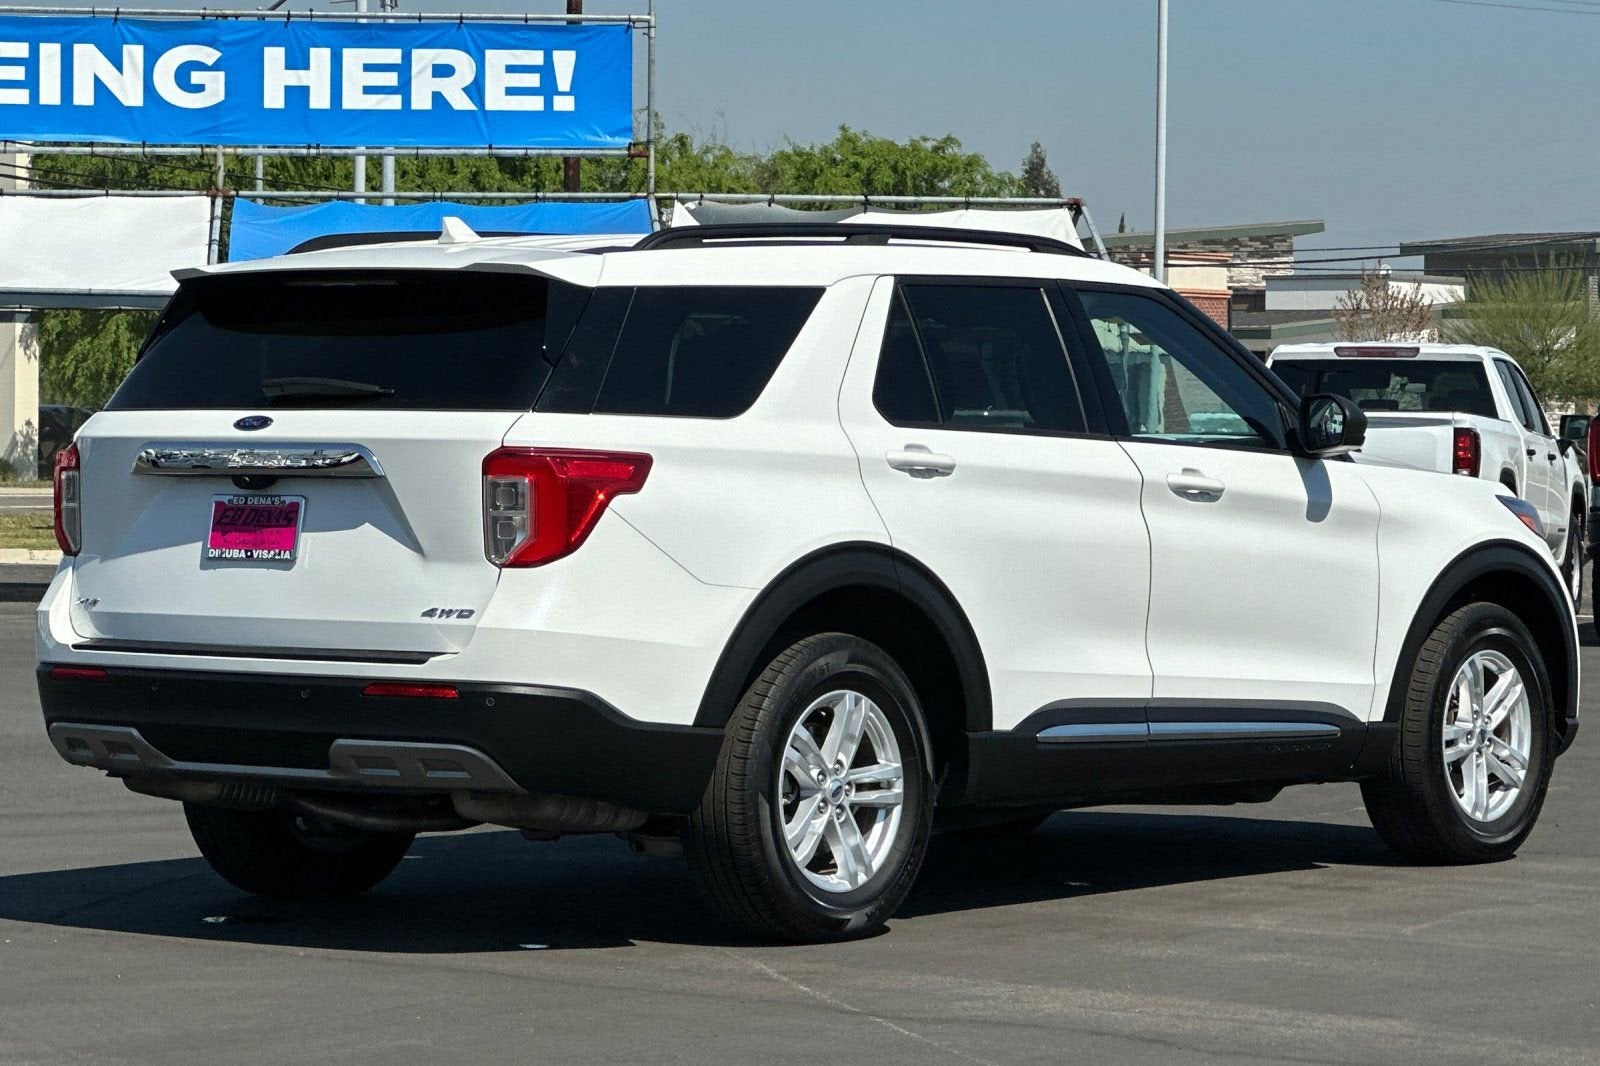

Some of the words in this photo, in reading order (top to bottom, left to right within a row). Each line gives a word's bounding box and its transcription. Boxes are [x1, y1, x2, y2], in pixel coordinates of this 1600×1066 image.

[263, 47, 576, 111] HERE!
[233, 496, 246, 505] ED
[247, 496, 281, 505] DENA'S
[420, 607, 475, 619] 4WD
